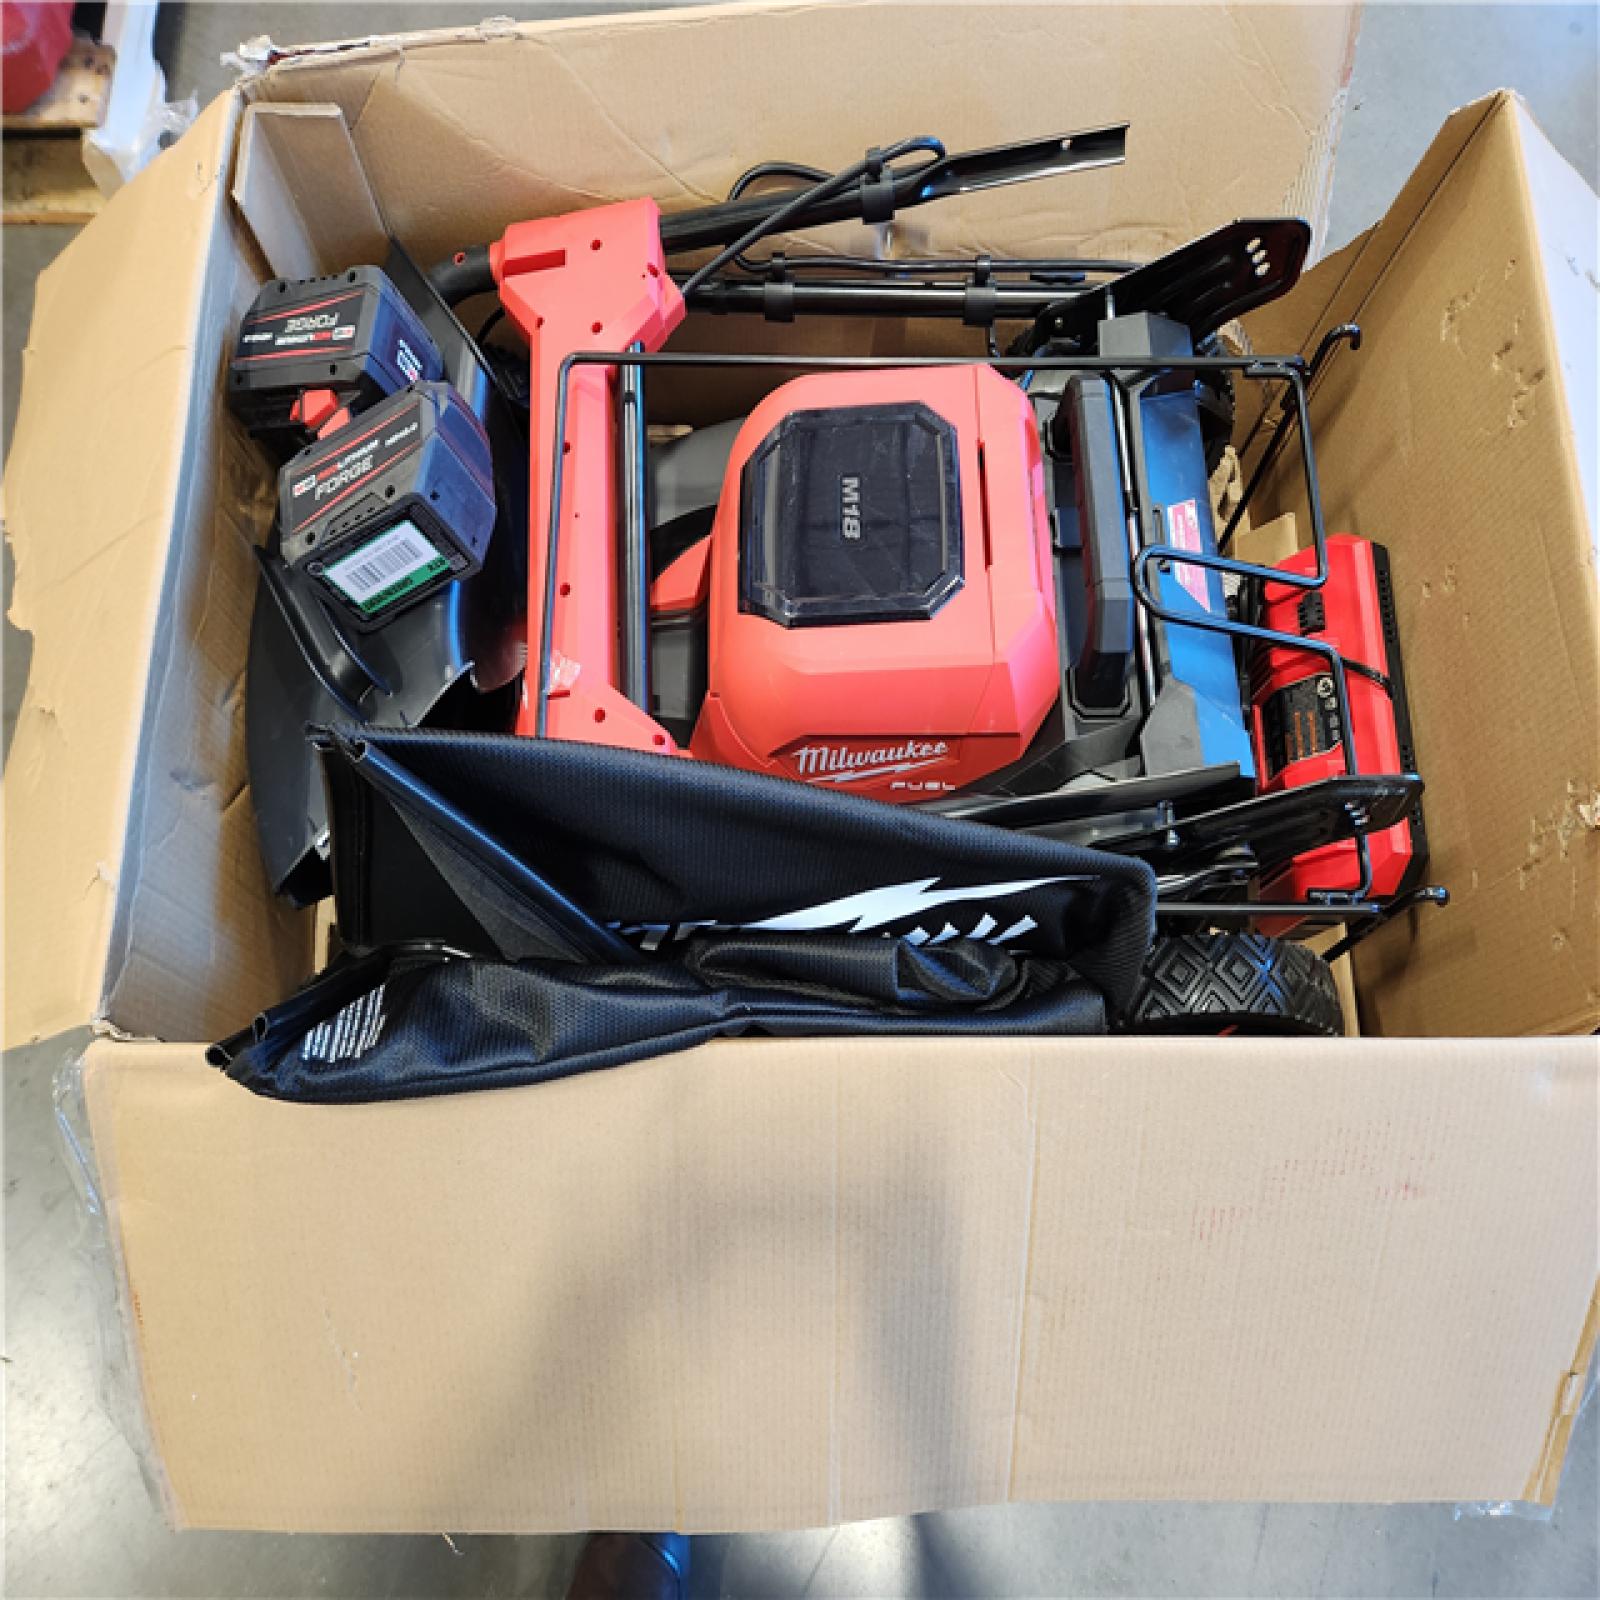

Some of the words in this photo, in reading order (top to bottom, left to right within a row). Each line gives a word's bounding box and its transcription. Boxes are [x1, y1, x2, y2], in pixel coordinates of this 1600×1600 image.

[286, 313, 339, 333] FORGE
[315, 455, 373, 500] FORGE
[841, 478, 861, 539] M18
[793, 740, 949, 774] Milwaukee
[890, 780, 956, 791] FUEL
